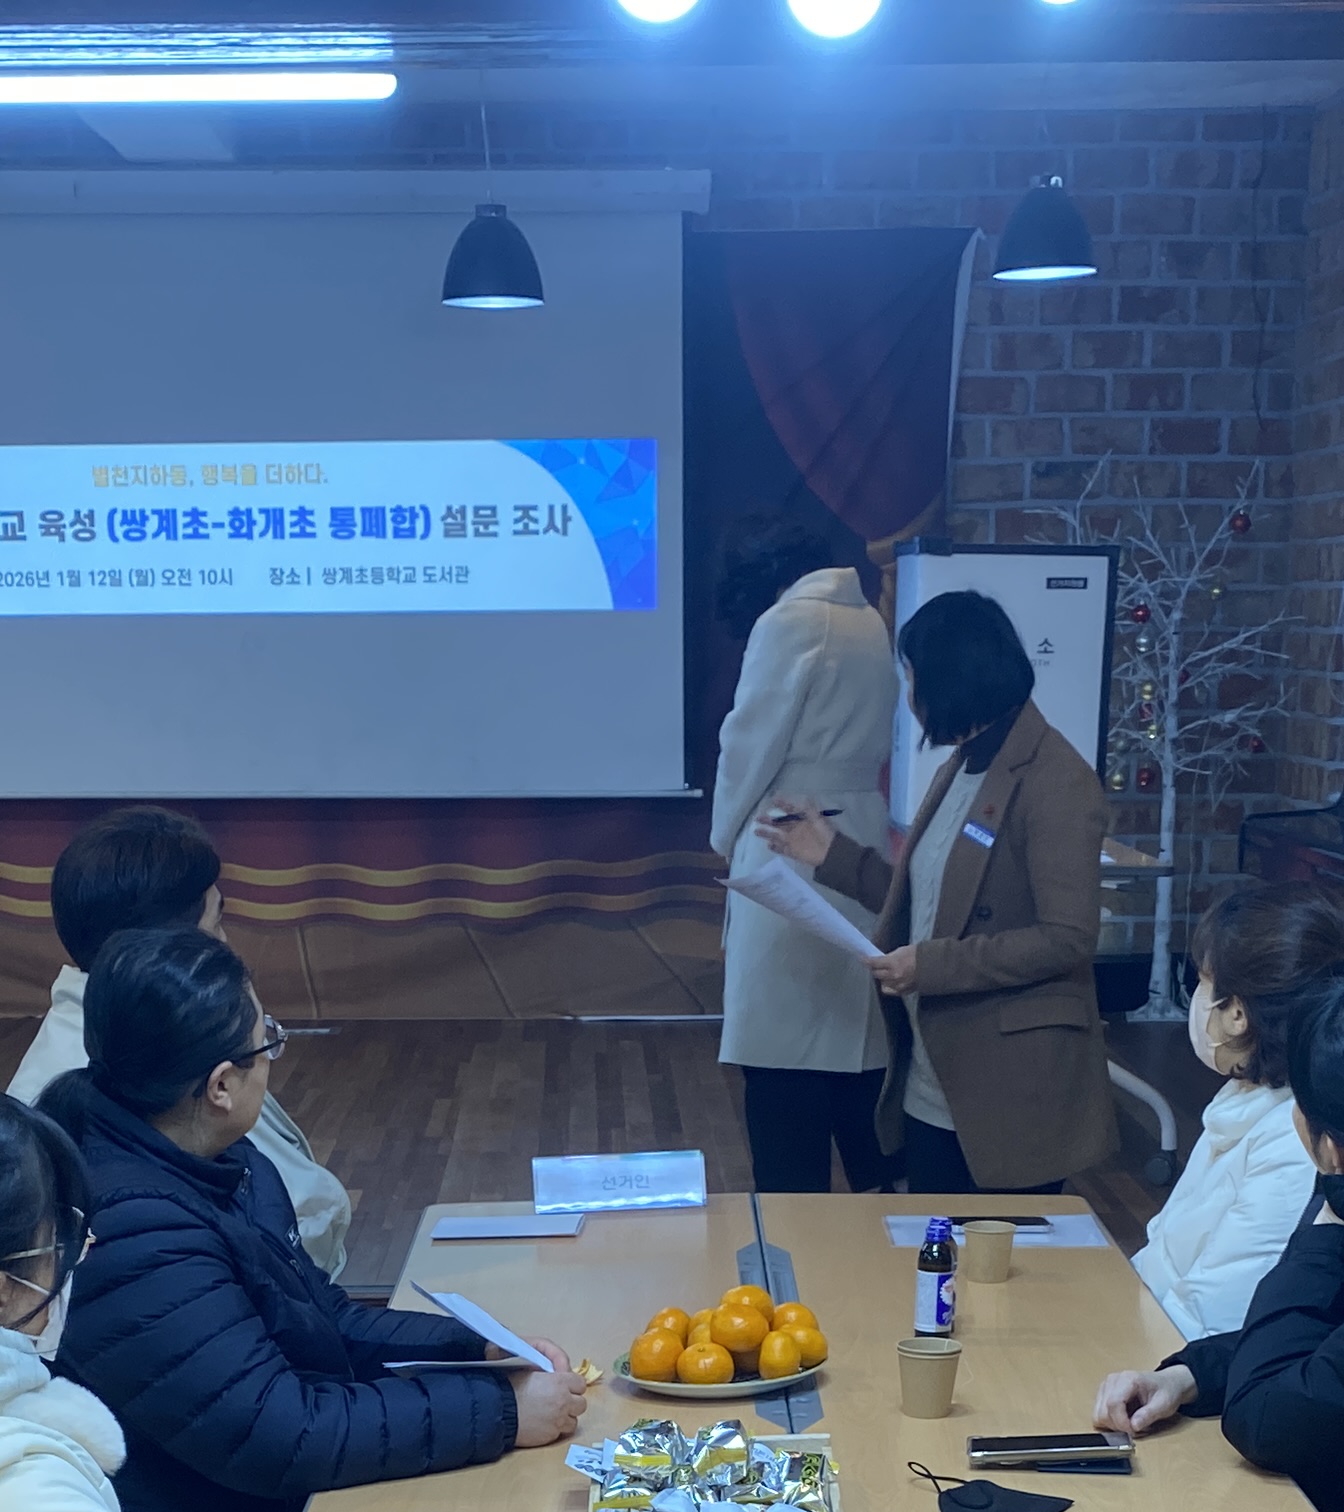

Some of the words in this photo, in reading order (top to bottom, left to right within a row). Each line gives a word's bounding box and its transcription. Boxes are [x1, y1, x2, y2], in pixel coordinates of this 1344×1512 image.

[92, 464, 194, 488] 별천지하동,
[201, 463, 257, 486] 행복을
[265, 462, 329, 485] 더하다.
[38, 508, 97, 543] 육성
[107, 505, 317, 543] (쌍계초-화개초
[328, 503, 432, 541] 통폐합)
[440, 503, 500, 539] 설문
[512, 502, 572, 537] 조사
[56, 569, 81, 588] 1월
[88, 568, 123, 588] 12일
[128, 567, 155, 588] (월)
[161, 567, 192, 587] 오전
[198, 567, 233, 587] 10시
[269, 566, 301, 586] 장소
[321, 565, 417, 586] 쌍계초등학교
[422, 565, 470, 585] 도서관
[601, 1174, 651, 1191] 선거인
